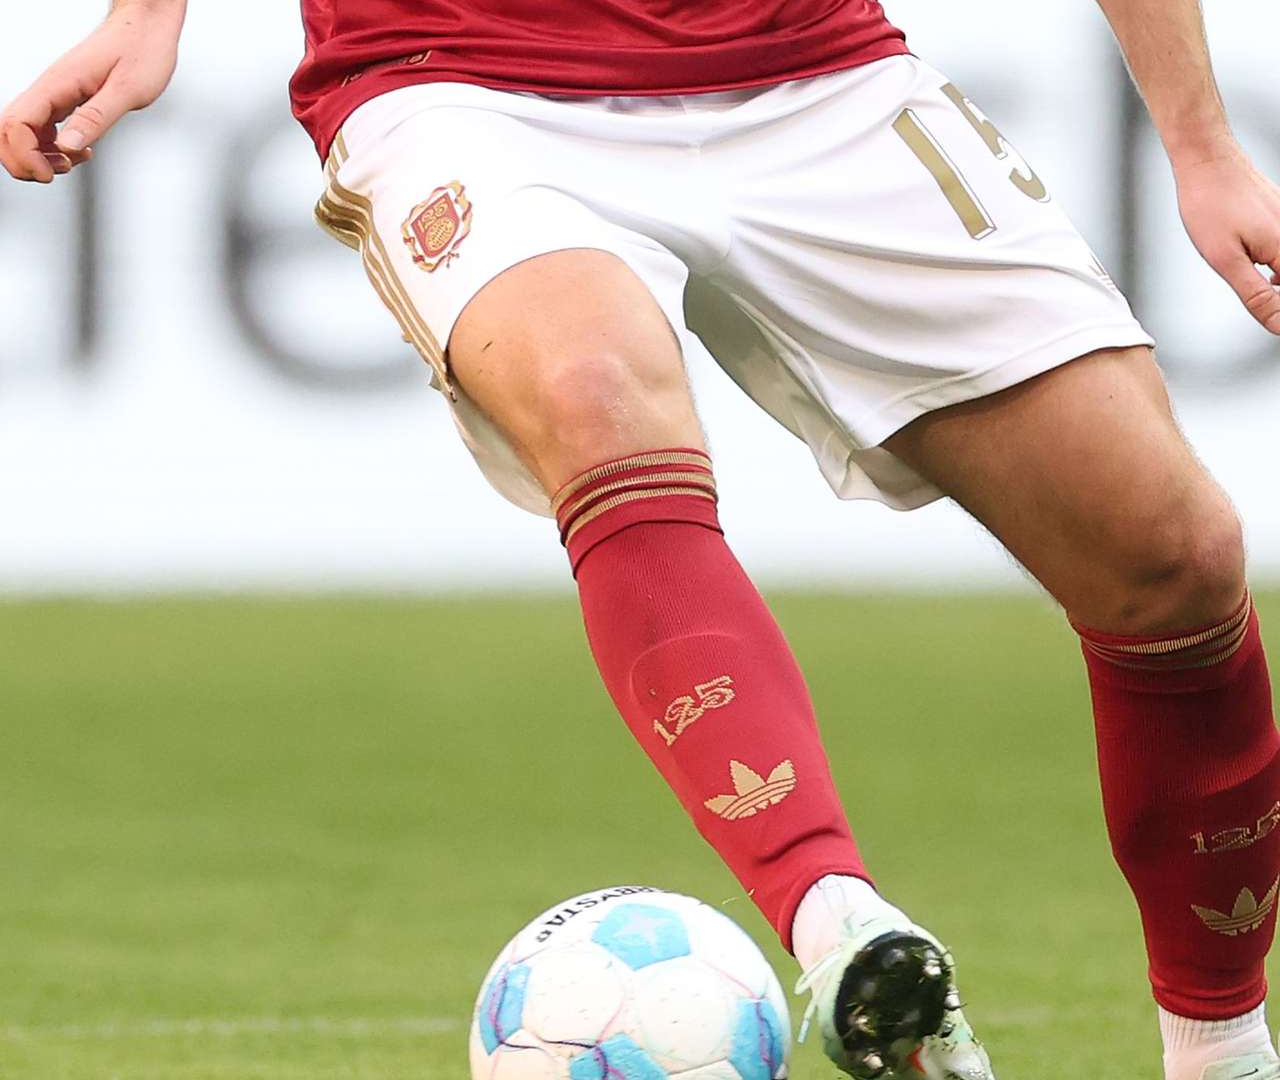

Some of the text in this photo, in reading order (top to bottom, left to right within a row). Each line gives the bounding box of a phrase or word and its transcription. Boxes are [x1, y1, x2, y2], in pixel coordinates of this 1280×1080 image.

[891, 81, 1051, 241] 15
[654, 675, 735, 747] 125
[1189, 801, 1280, 854] 125
